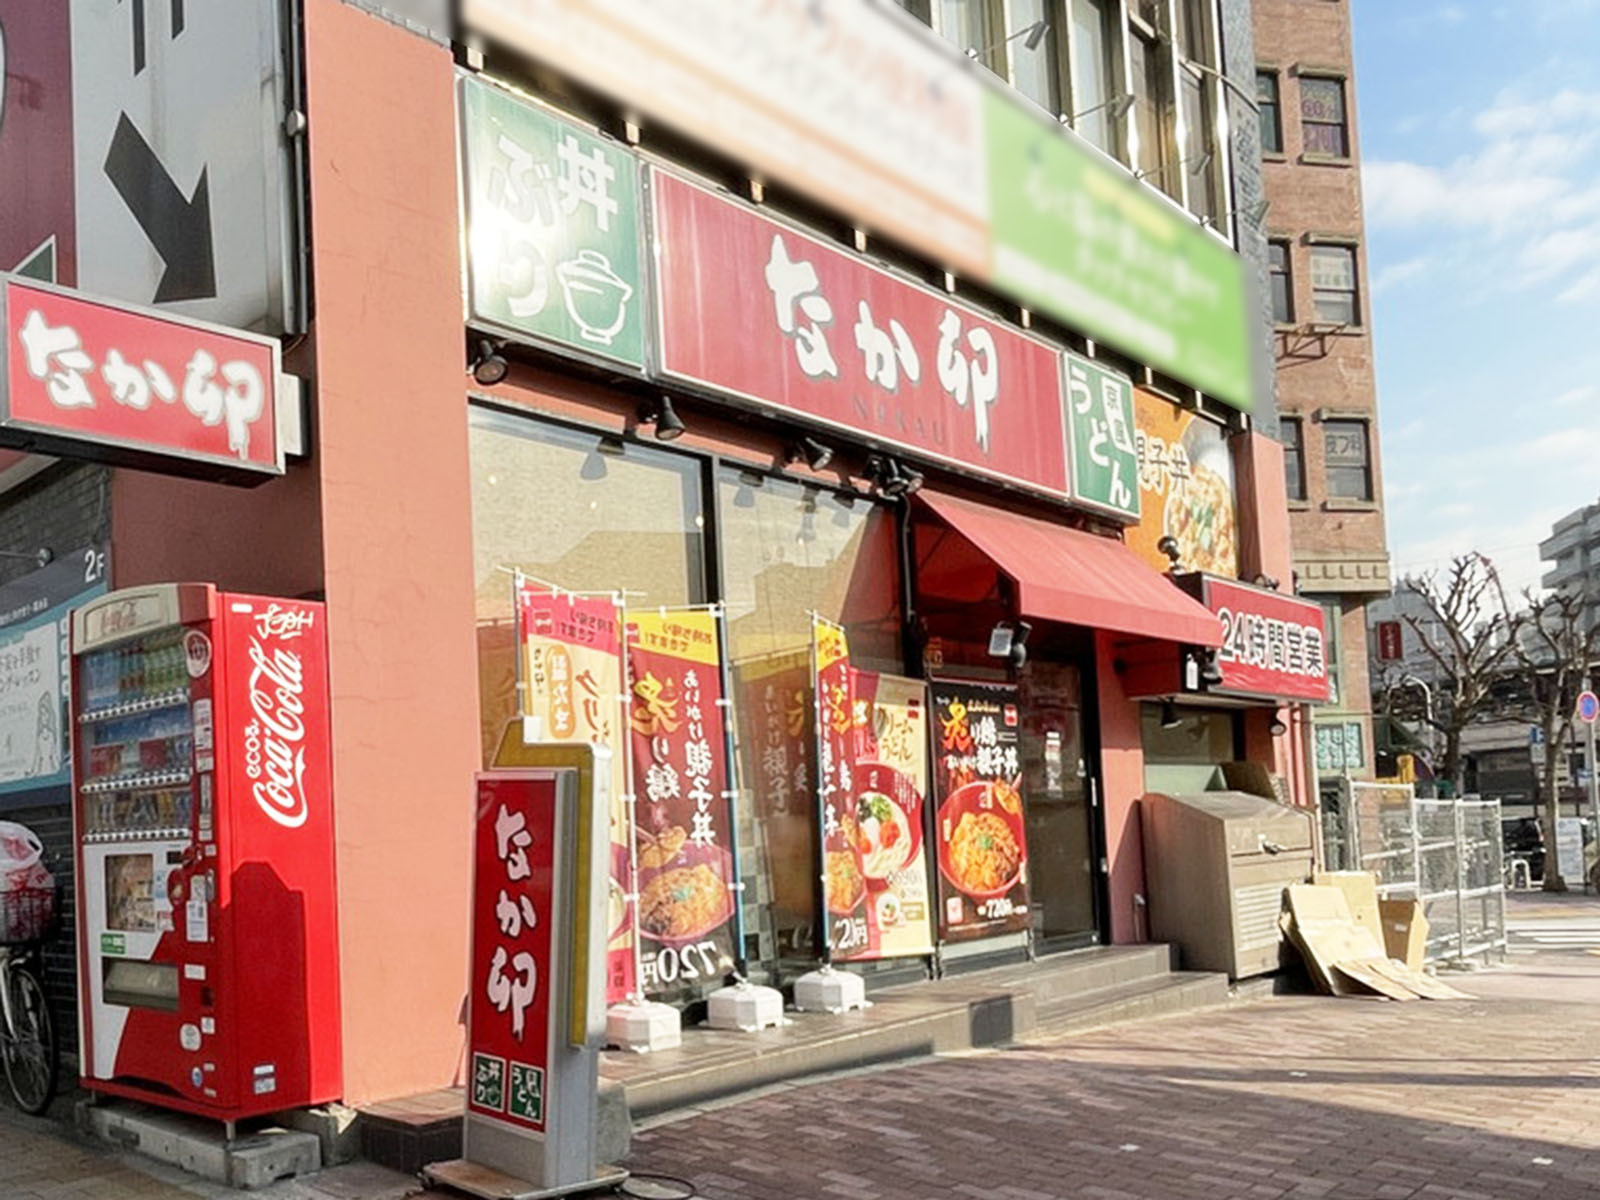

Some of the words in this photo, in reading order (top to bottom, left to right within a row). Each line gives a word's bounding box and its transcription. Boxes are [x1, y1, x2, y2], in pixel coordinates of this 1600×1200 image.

[20, 309, 265, 460] なか卯
[765, 234, 999, 454] なか卯
[1070, 366, 1131, 509] うどん
[84, 550, 105, 583] 2F
[1217, 606, 1325, 679] 24時間営業
[248, 634, 309, 828] Coca-Cola
[486, 803, 538, 1043] なか卯
